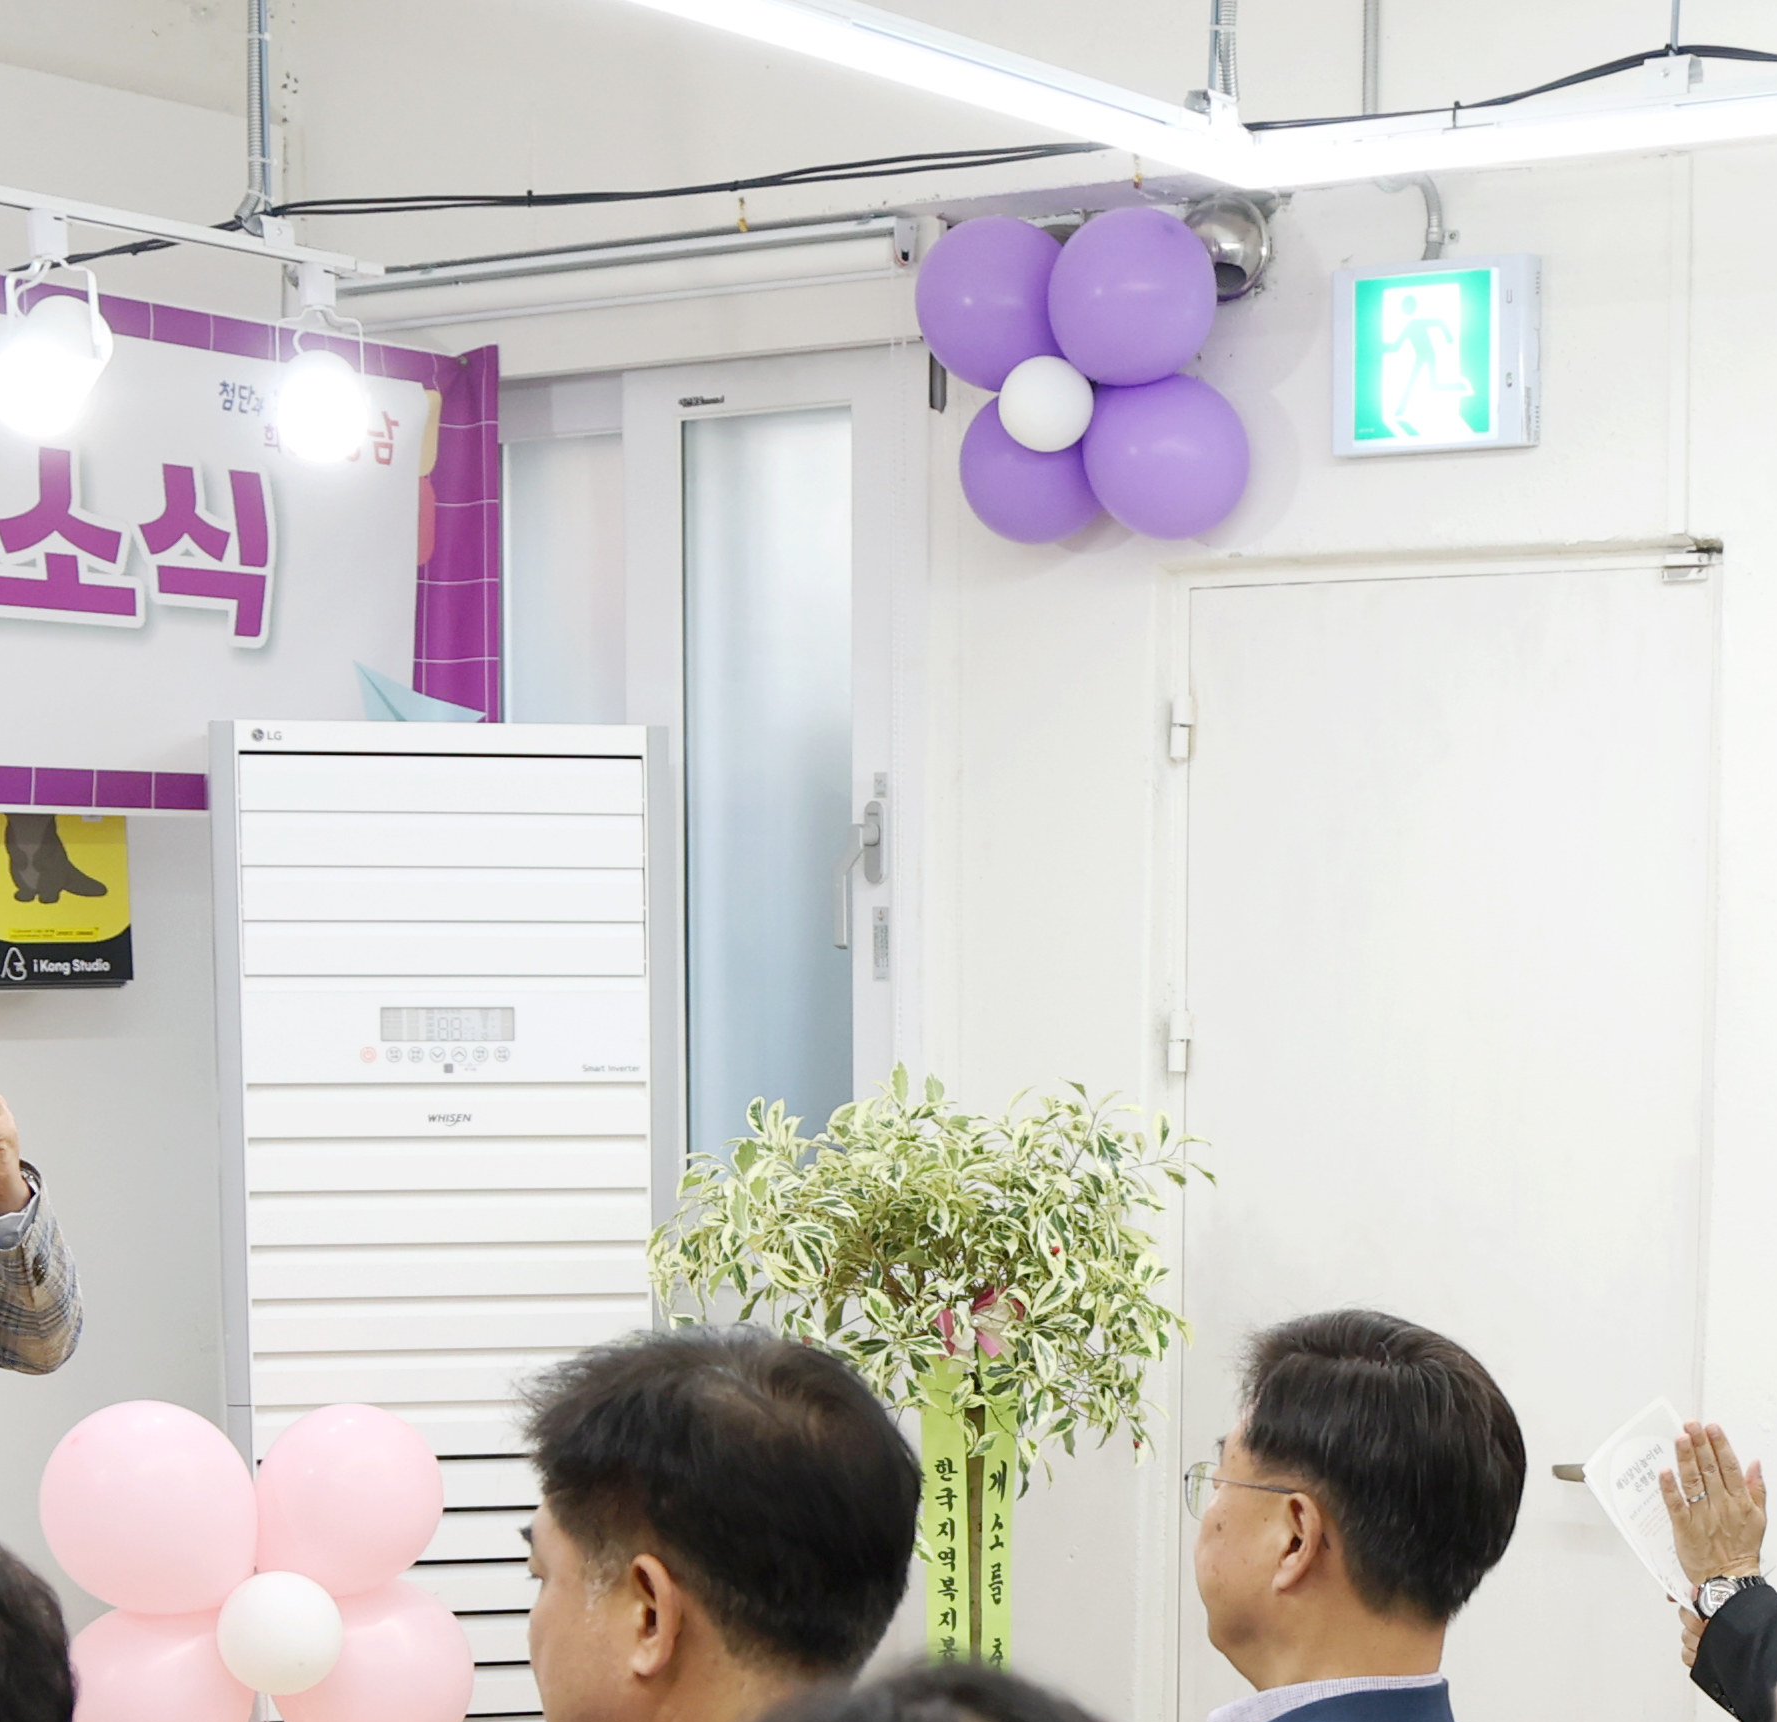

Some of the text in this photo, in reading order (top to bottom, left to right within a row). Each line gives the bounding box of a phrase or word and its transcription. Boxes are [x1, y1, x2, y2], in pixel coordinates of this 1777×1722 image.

[266, 730, 282, 741] LG
[72, 957, 112, 973] Studio
[582, 1063, 641, 1073] Smart Inverter
[427, 1113, 473, 1125] WHISEN
